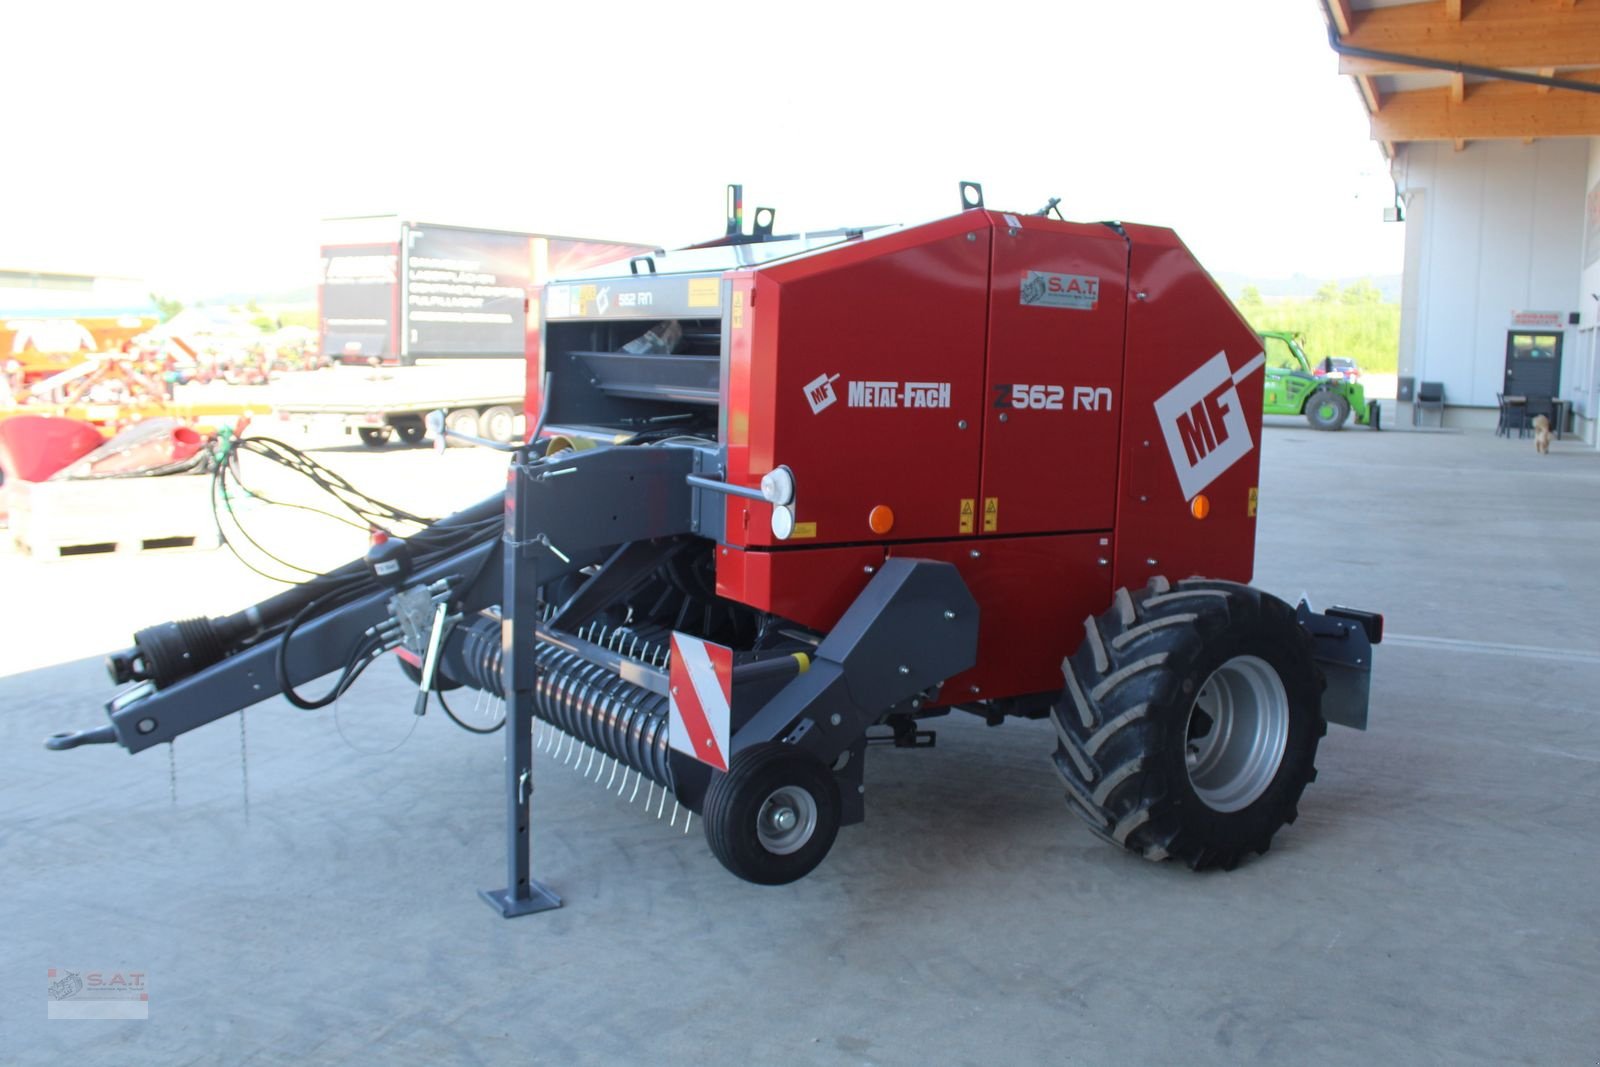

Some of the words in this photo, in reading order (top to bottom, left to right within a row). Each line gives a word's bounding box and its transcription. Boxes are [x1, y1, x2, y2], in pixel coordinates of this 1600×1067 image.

[1048, 276, 1097, 295] S.A.T.
[848, 381, 951, 408] METAL-FACH
[993, 383, 1065, 410] Z562
[1175, 377, 1235, 469] MF
